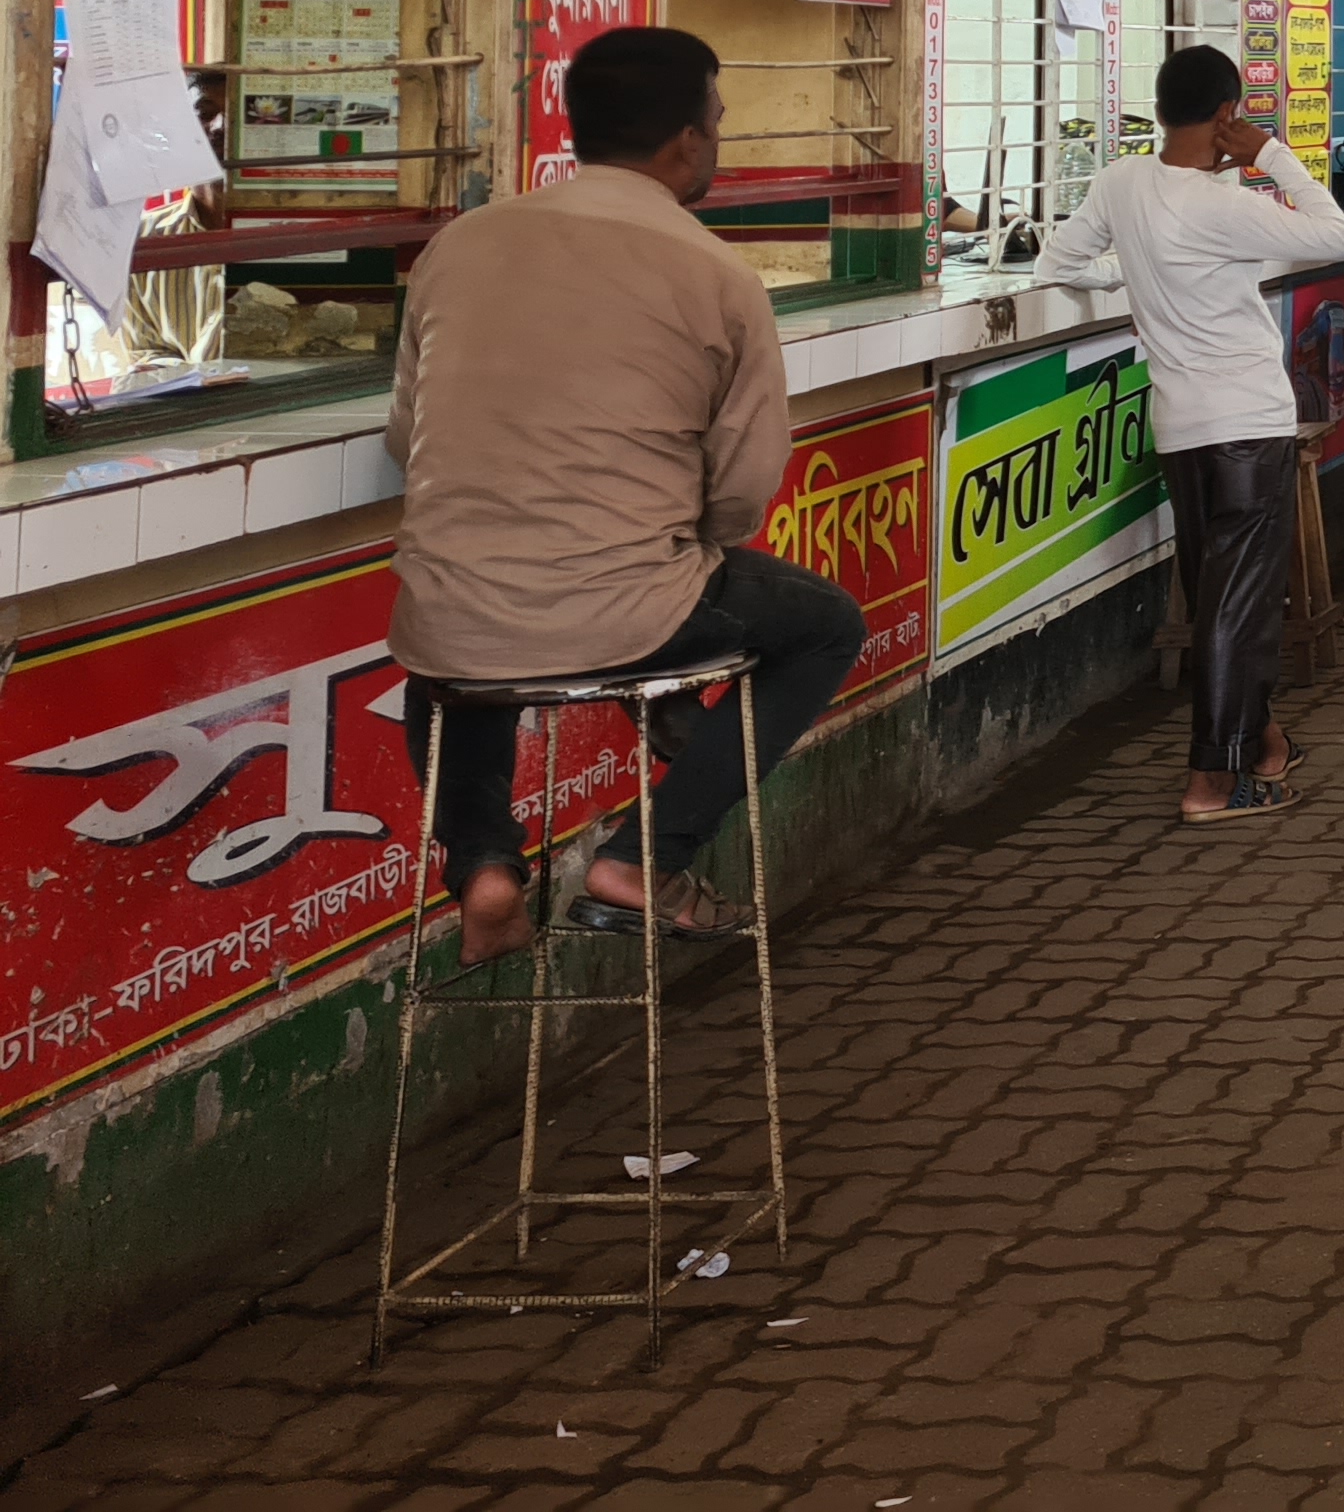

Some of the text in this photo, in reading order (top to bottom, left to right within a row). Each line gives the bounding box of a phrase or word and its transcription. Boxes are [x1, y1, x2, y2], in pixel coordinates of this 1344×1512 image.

[766, 450, 925, 585] পরিবহন
[951, 358, 1152, 564] সেবা গ্রীন
